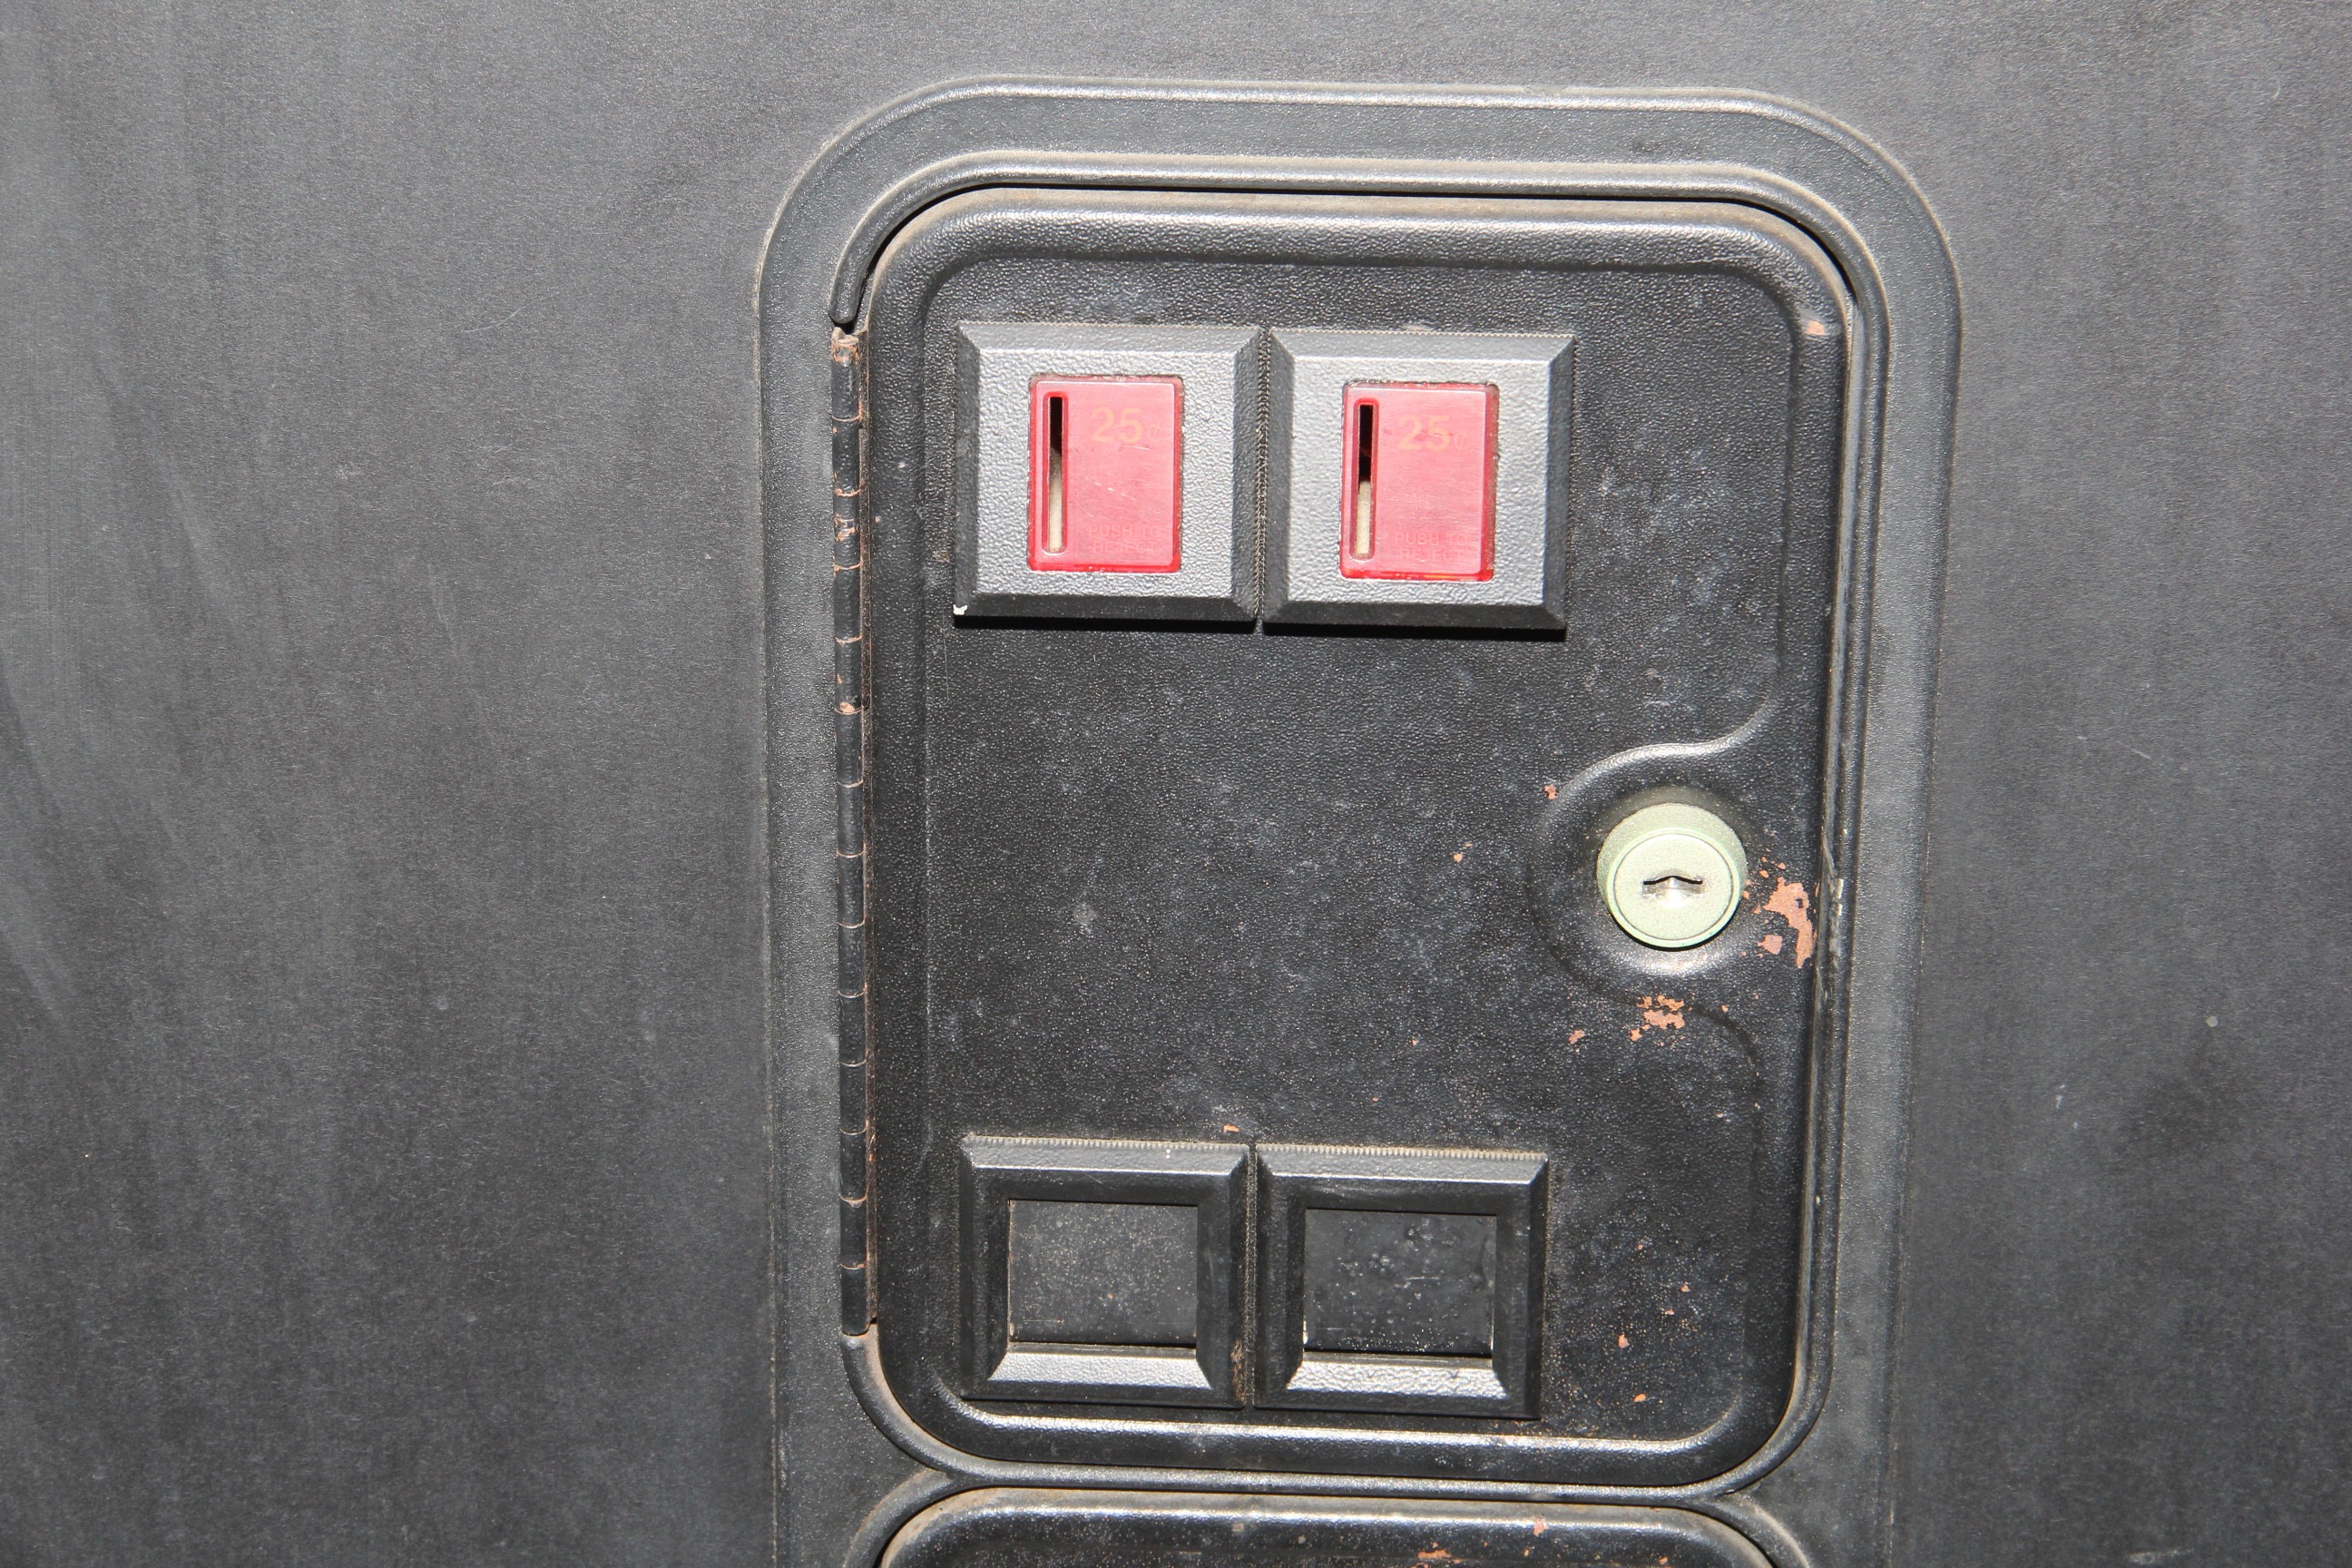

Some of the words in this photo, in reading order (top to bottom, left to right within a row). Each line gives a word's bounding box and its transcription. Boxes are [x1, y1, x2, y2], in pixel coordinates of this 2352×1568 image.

[1088, 523, 1134, 538] PUSH
[1140, 524, 1163, 538] TO
[1092, 539, 1157, 554] REJECT
[1394, 531, 1440, 546] PUSH
[1445, 532, 1469, 547] TO
[1399, 548, 1465, 563] REJECT
